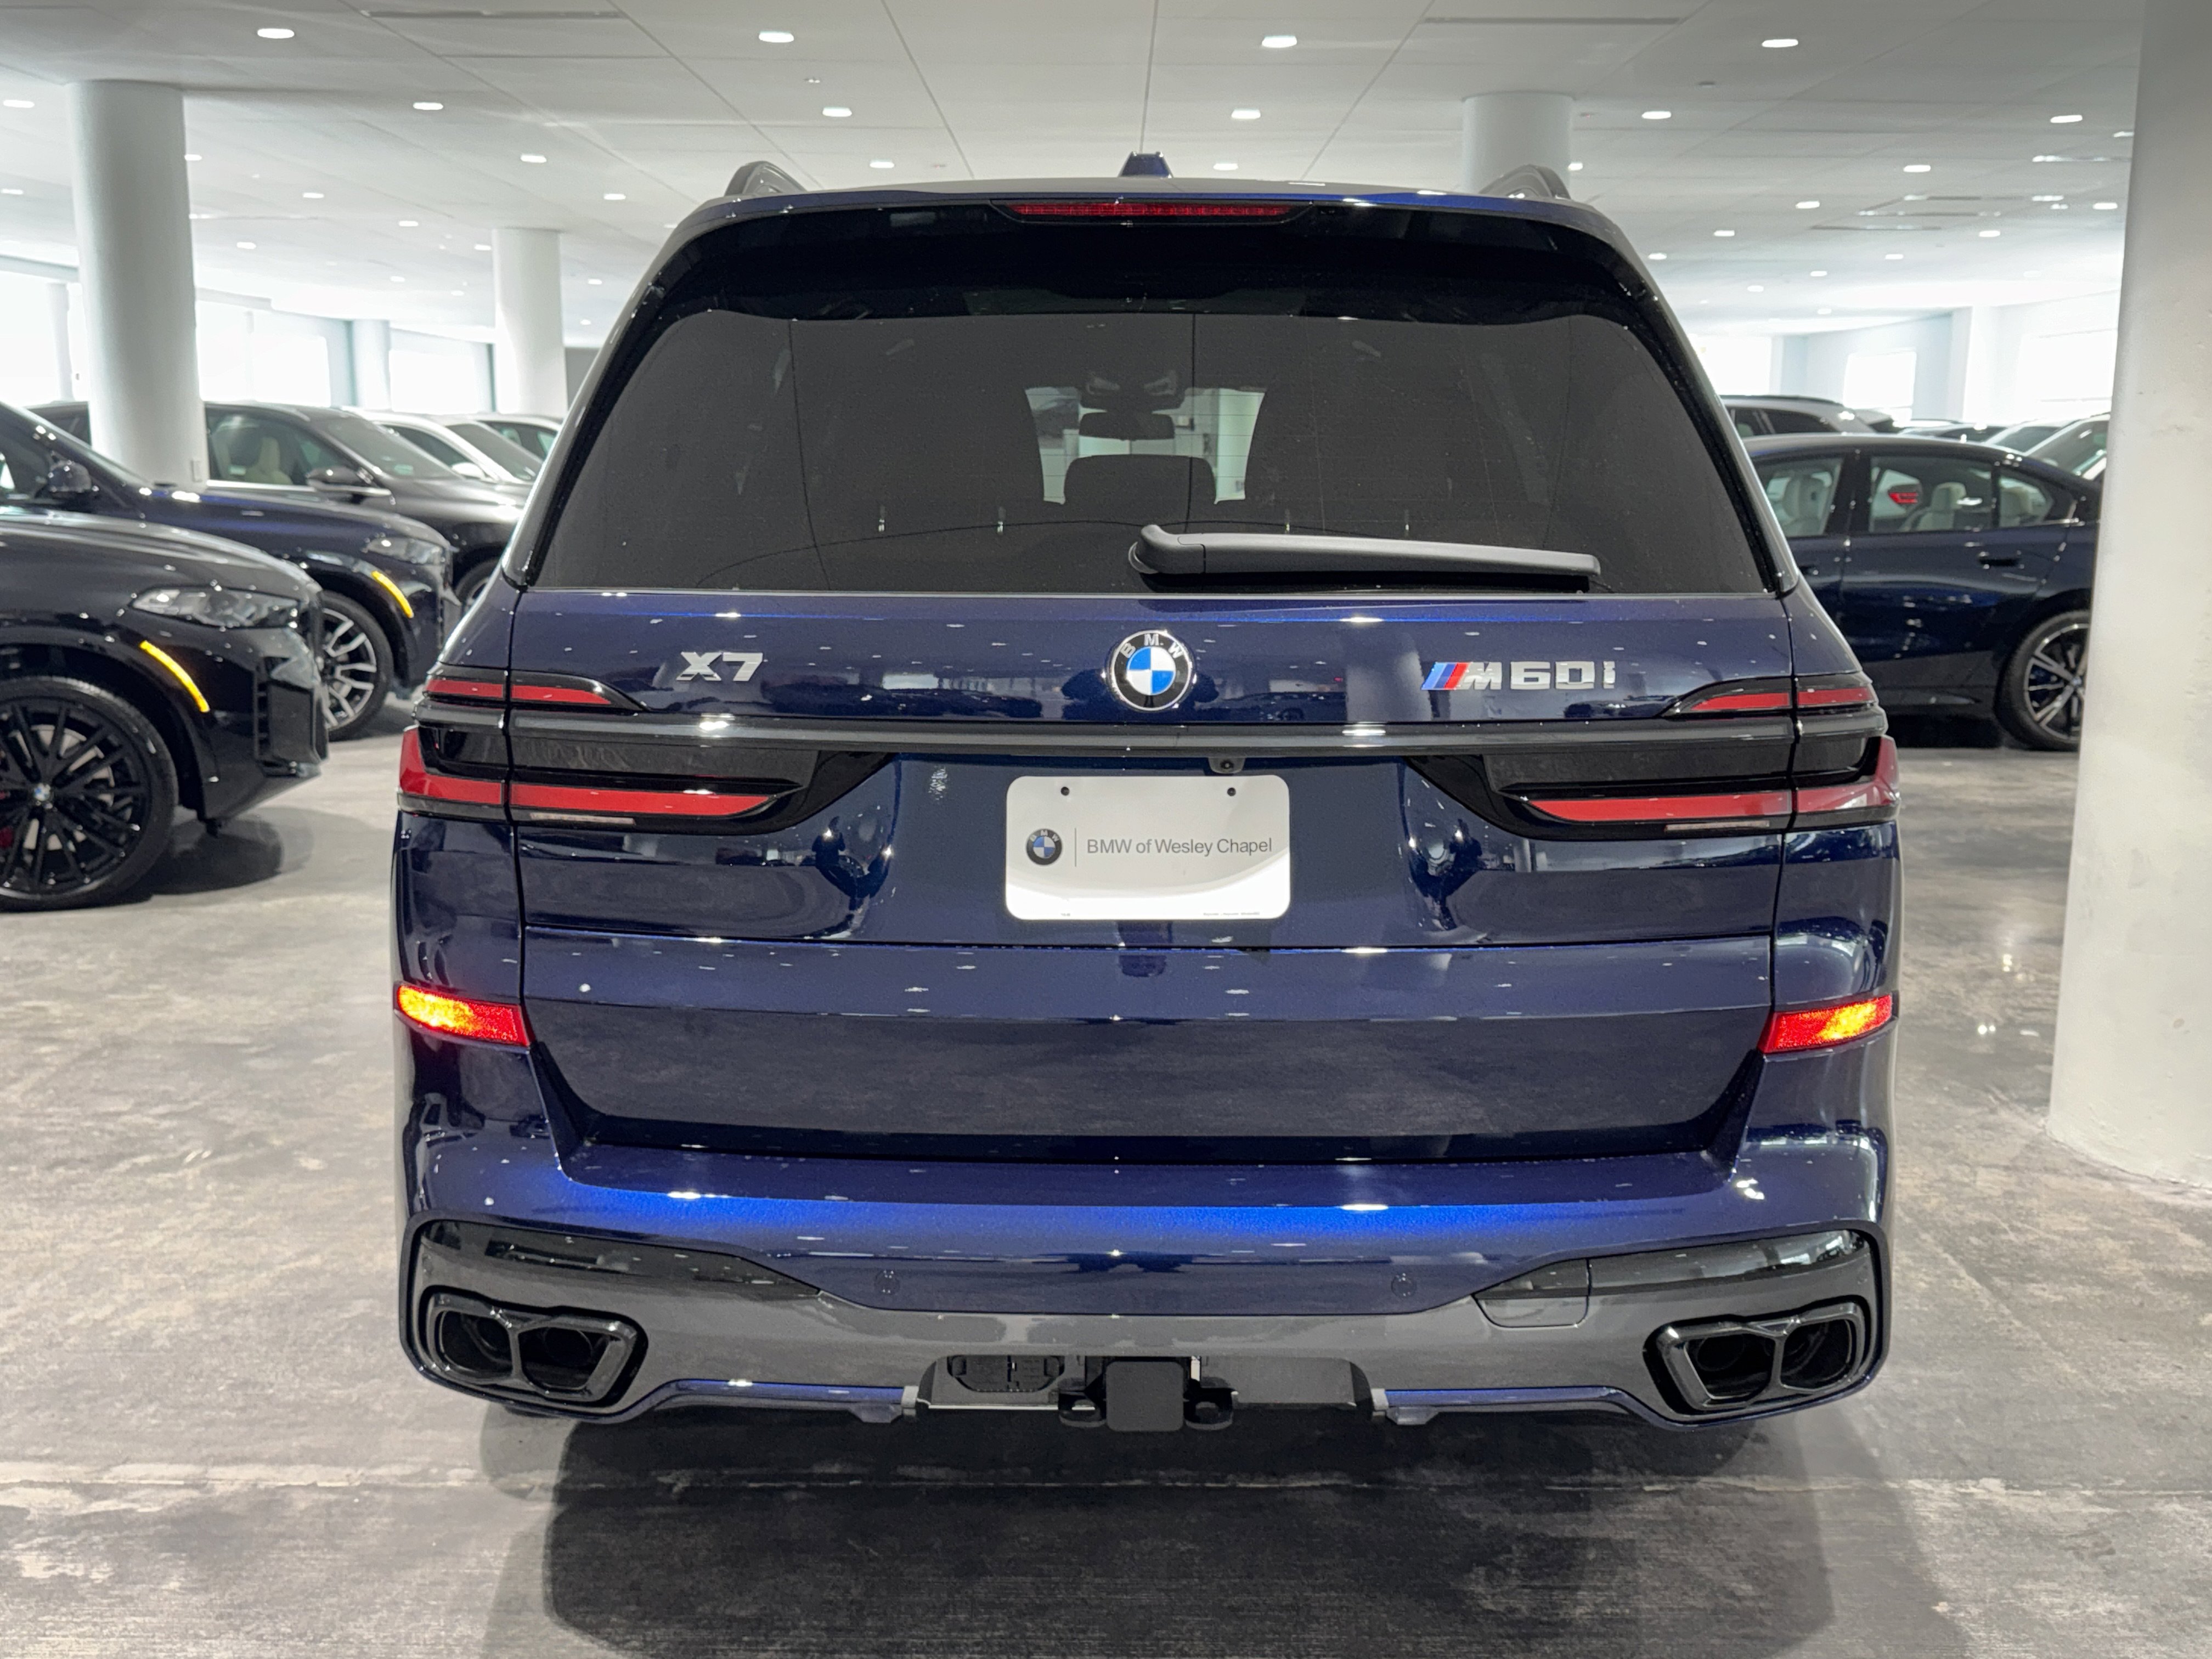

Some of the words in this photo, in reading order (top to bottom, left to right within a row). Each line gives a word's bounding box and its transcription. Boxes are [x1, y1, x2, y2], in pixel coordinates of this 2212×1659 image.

[1120, 633, 1184, 659] BMW
[676, 651, 763, 681] X7
[1087, 839, 1132, 854] BMW
[1136, 839, 1152, 854] of
[1154, 838, 1214, 857] Wesley
[1217, 838, 1272, 856] Chapel
